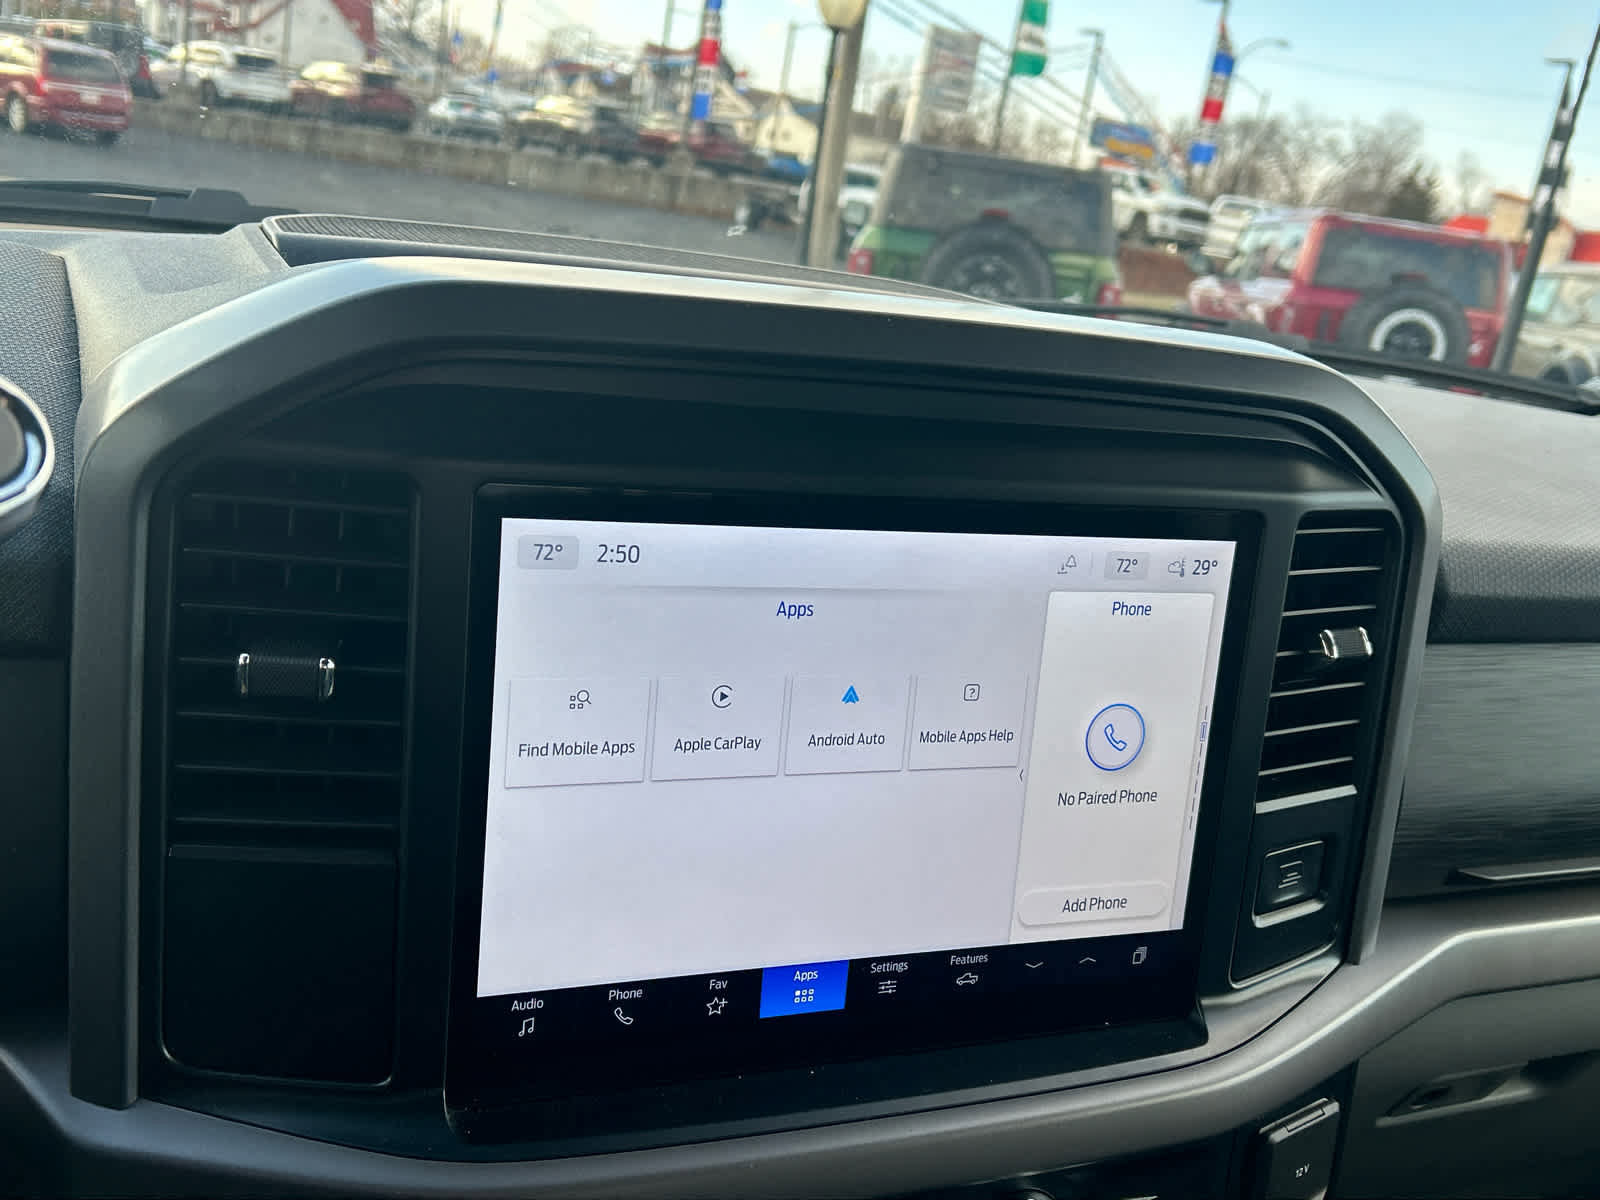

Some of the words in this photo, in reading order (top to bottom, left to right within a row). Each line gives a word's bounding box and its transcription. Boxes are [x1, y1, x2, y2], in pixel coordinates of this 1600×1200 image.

[596, 543, 640, 564] 2:50
[776, 600, 814, 620] Apps
[1111, 601, 1152, 617] Phone
[673, 737, 712, 754] Apple
[713, 735, 762, 751] CarPlay
[807, 733, 855, 747] Android
[856, 732, 886, 745] Auto
[919, 730, 957, 744] Mobile
[958, 729, 987, 745] Apps
[988, 728, 1014, 744] Help
[518, 741, 551, 758] Find
[552, 740, 599, 757] Mobile
[600, 740, 636, 757] Apps
[1057, 792, 1076, 807] No
[1077, 790, 1119, 806] Paired
[1118, 789, 1158, 804] Phone
[1061, 897, 1089, 913] Add
[1088, 896, 1128, 912] Phone
[870, 959, 910, 974] Settings
[949, 952, 990, 966] Features
[709, 978, 728, 991] Fav
[793, 970, 819, 983] Apps
[608, 988, 643, 1001] Phone
[511, 997, 544, 1012] Audio
